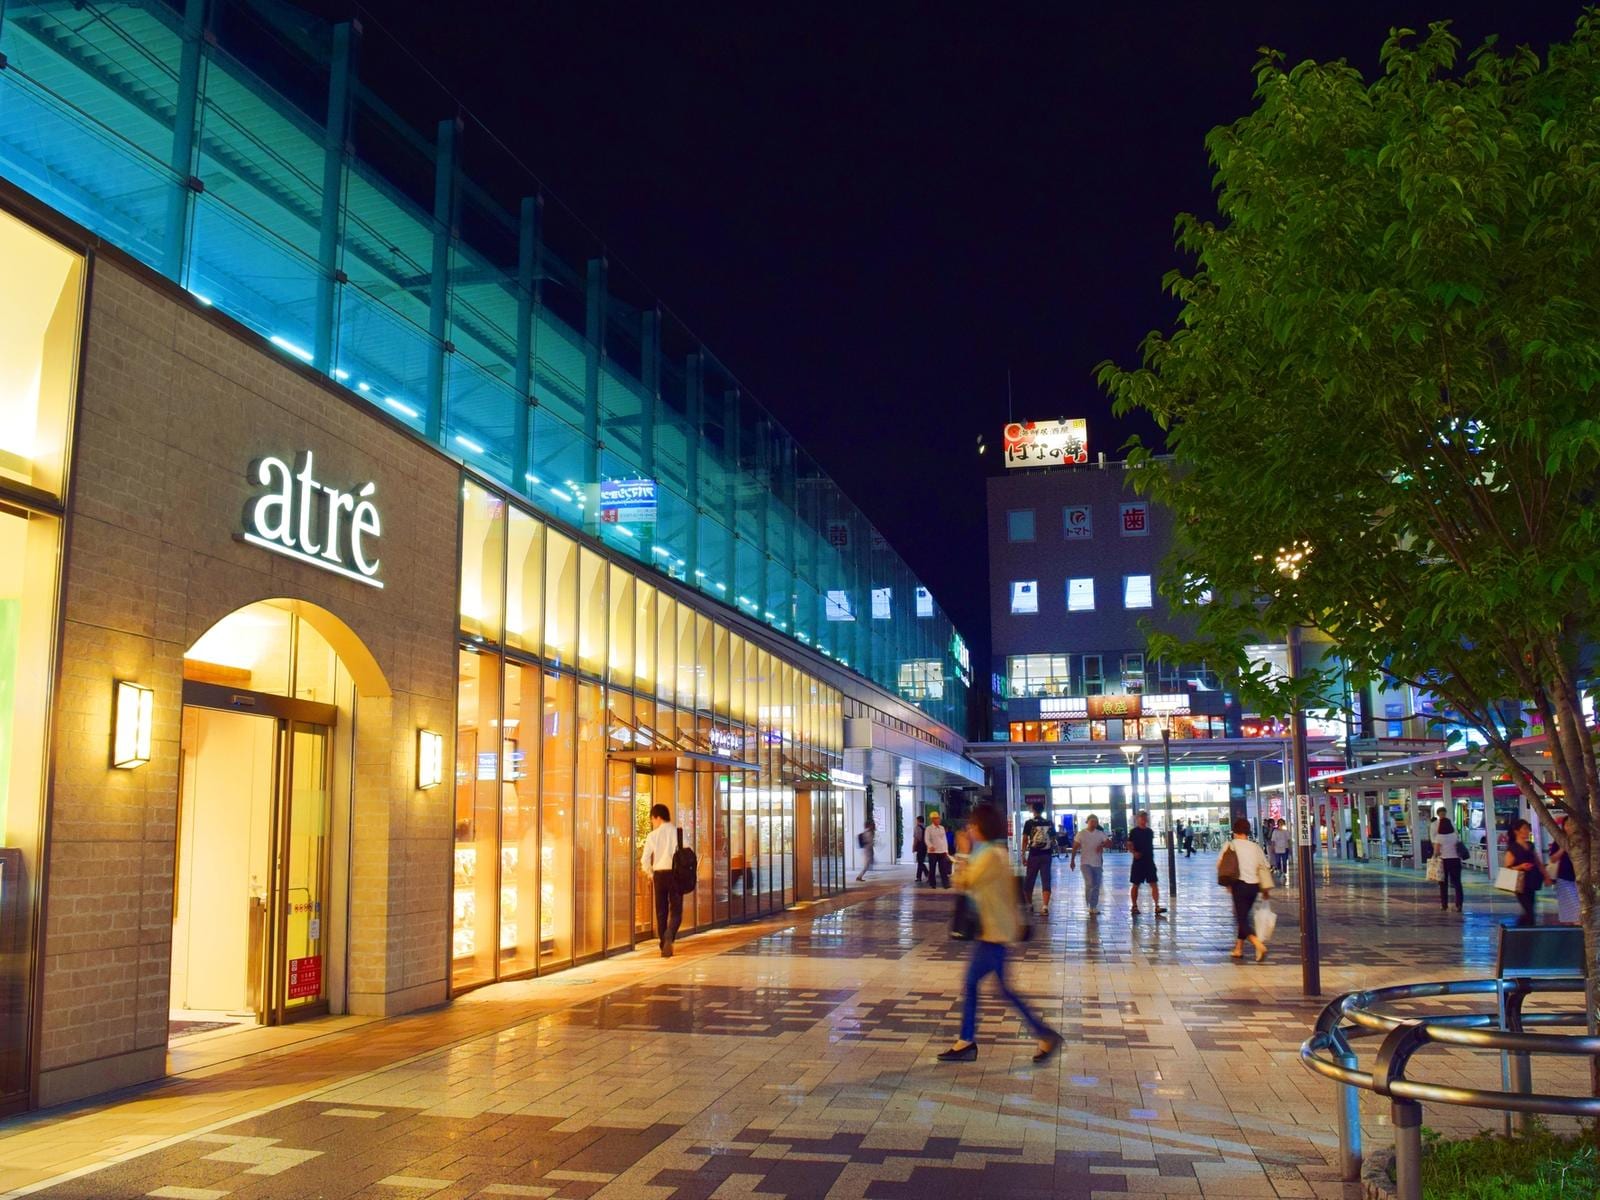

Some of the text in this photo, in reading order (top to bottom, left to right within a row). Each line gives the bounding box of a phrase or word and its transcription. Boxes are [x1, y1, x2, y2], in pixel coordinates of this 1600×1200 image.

[1008, 434, 1084, 462] はなの舞
[254, 450, 381, 576] atré
[1123, 508, 1145, 531] 歯
[1066, 527, 1091, 536] トマト
